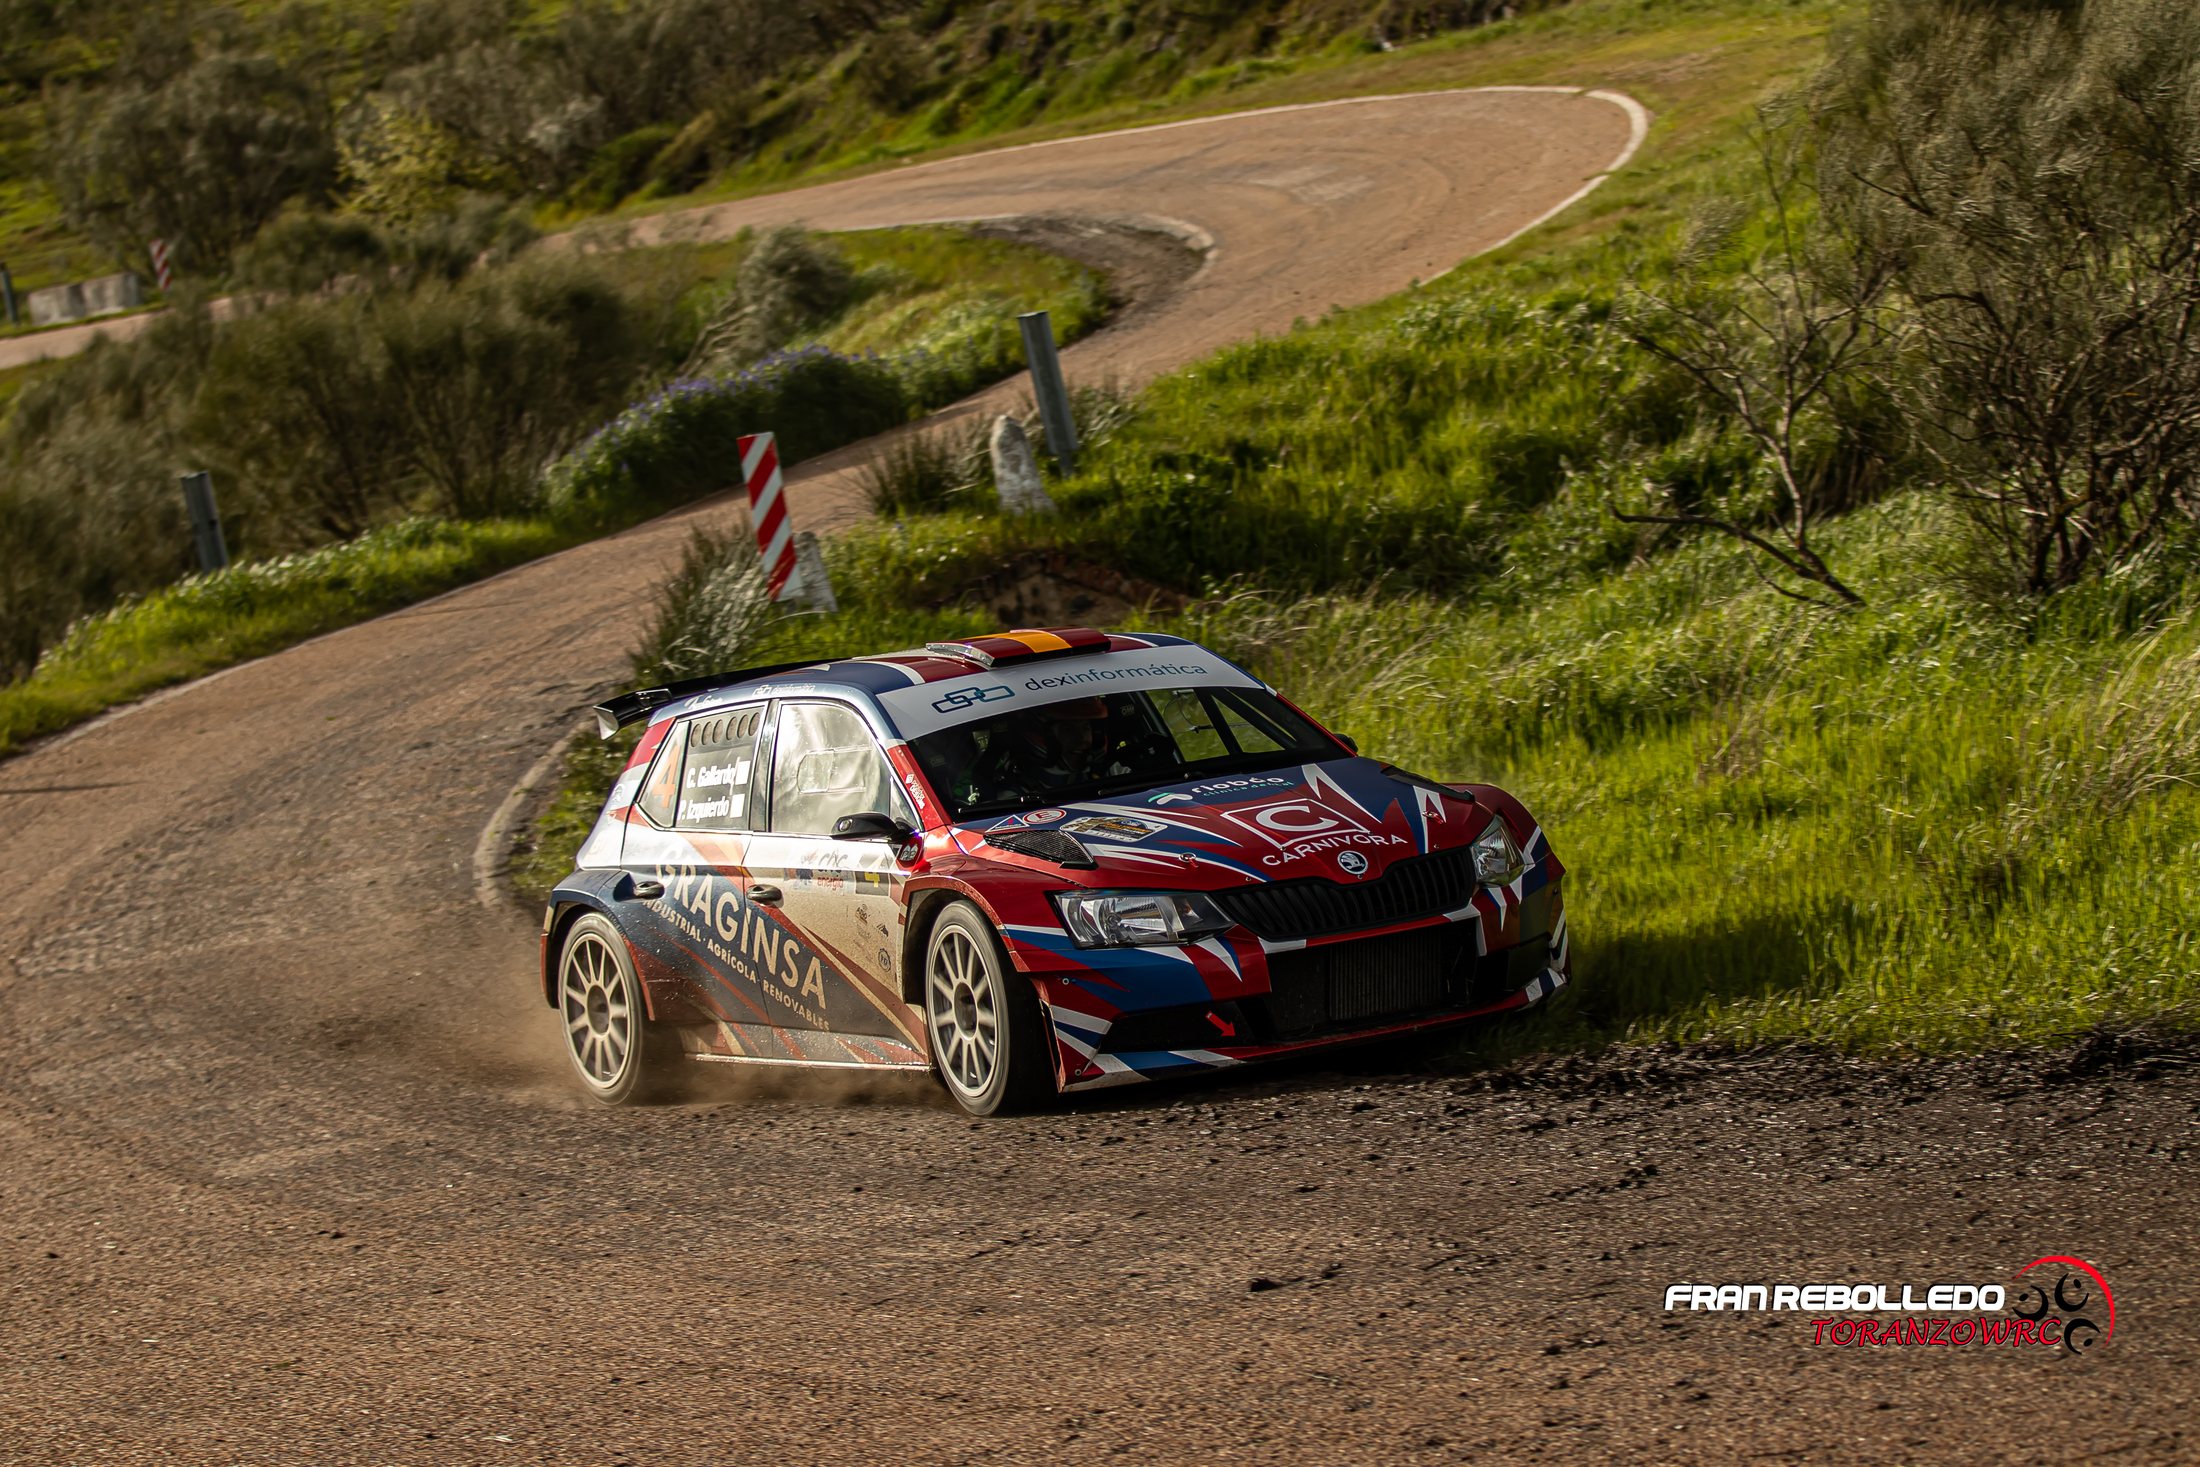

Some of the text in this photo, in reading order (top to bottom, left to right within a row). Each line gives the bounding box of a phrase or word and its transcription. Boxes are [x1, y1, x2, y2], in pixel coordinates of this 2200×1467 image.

[1025, 663, 1208, 691] dexinformática
[652, 744, 677, 809] 4
[687, 795, 729, 823] Izquierdo
[1262, 834, 1408, 866] CARNIVORA
[643, 899, 830, 1031] NDUSTRIAL AGRÍCOLA RENOVABLES
